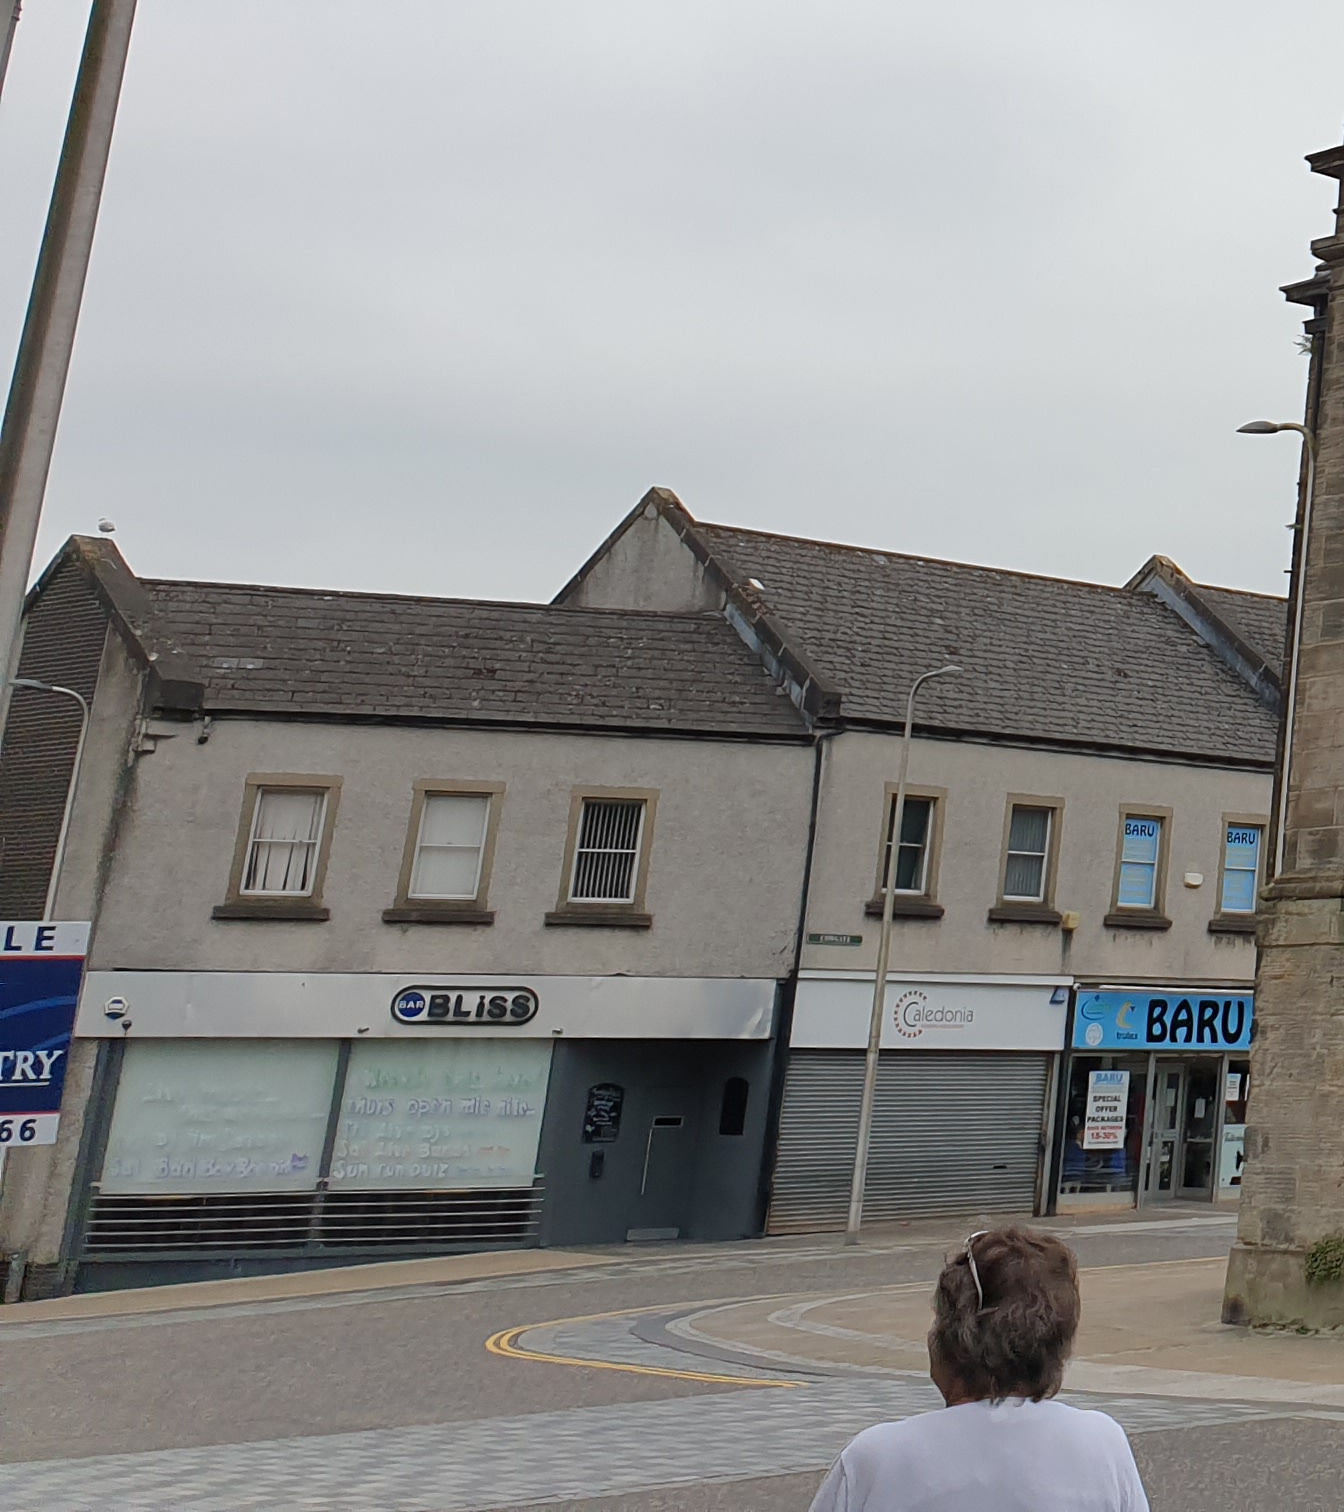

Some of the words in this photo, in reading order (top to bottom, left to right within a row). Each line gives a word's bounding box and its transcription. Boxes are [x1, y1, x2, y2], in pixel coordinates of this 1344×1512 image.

[1125, 823, 1155, 837] BARU
[1227, 832, 1256, 845] BARU
[400, 1000, 424, 1009] BAR
[903, 1001, 973, 1027] Caledonia
[1146, 998, 1245, 1044] BARU
